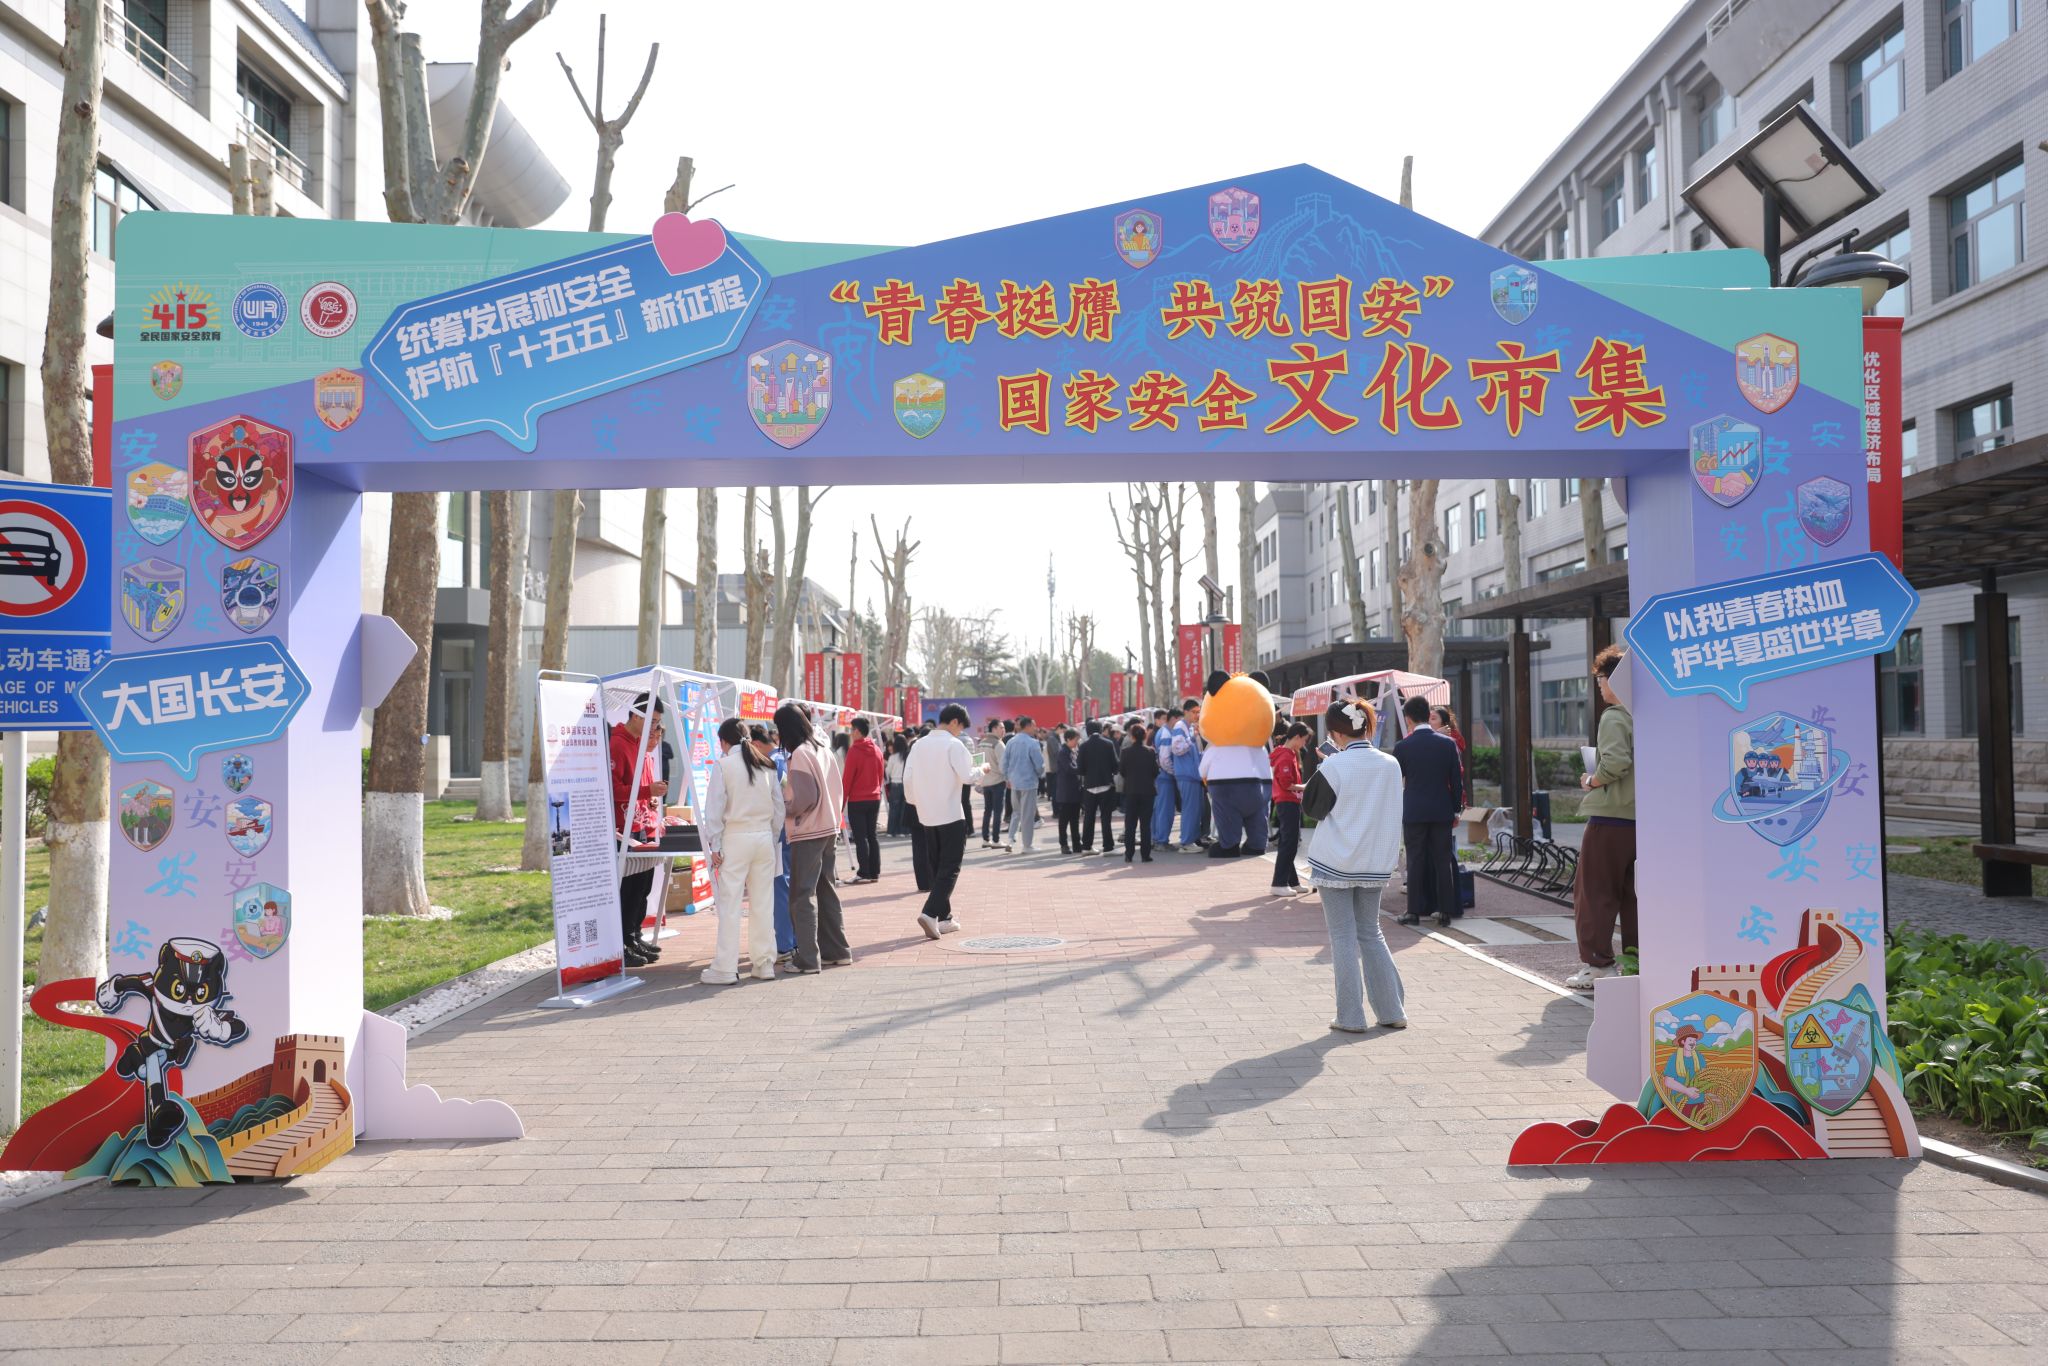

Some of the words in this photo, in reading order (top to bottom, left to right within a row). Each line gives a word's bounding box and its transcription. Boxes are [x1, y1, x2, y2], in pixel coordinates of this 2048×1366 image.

[152, 304, 208, 330] 415
[396, 265, 635, 361] 统筹发展和安全
[140, 331, 221, 342] 全民国家安全教育
[1864, 351, 1882, 484] 优化区域经济布局
[1664, 578, 1847, 642] 以我青春热血
[0, 648, 112, 672] 动车通
[1671, 608, 1885, 679] 护华夏盛世华章
[35, 681, 55, 694] OF
[102, 663, 289, 730] 大国长安
[183, 788, 223, 830] 安
[144, 848, 198, 898] 安
[1845, 843, 1878, 881] 安
[111, 919, 153, 960] 安
[1737, 905, 1777, 946] 安
